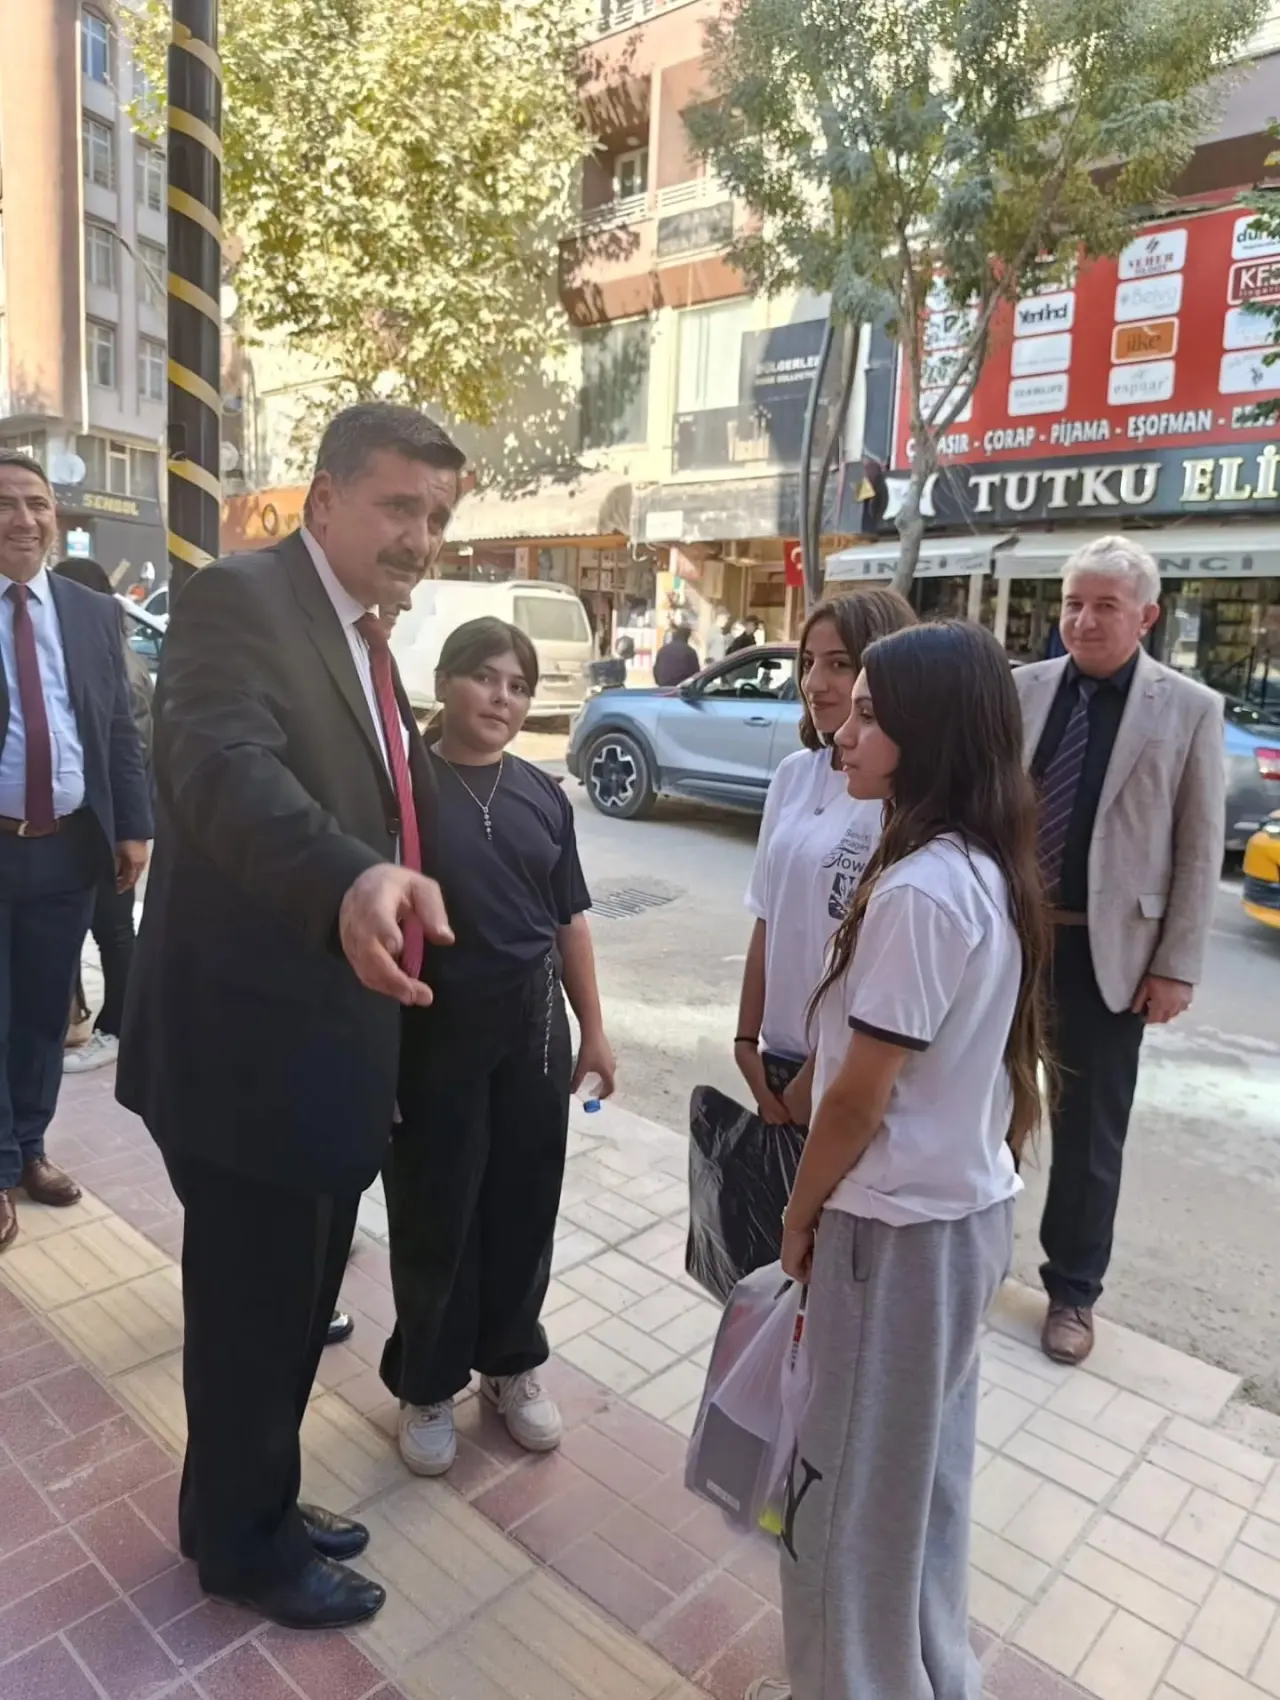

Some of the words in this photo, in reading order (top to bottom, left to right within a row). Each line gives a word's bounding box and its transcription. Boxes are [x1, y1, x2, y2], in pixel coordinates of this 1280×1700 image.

[906, 434, 969, 463] ÇAŞIR
[984, 426, 1036, 456] ÇORAP
[1051, 417, 1109, 447] PİJAMA
[1127, 409, 1213, 443] EŞOFMAN
[967, 462, 1162, 513] TUTKU
[1158, 556, 1254, 573] NCİ
